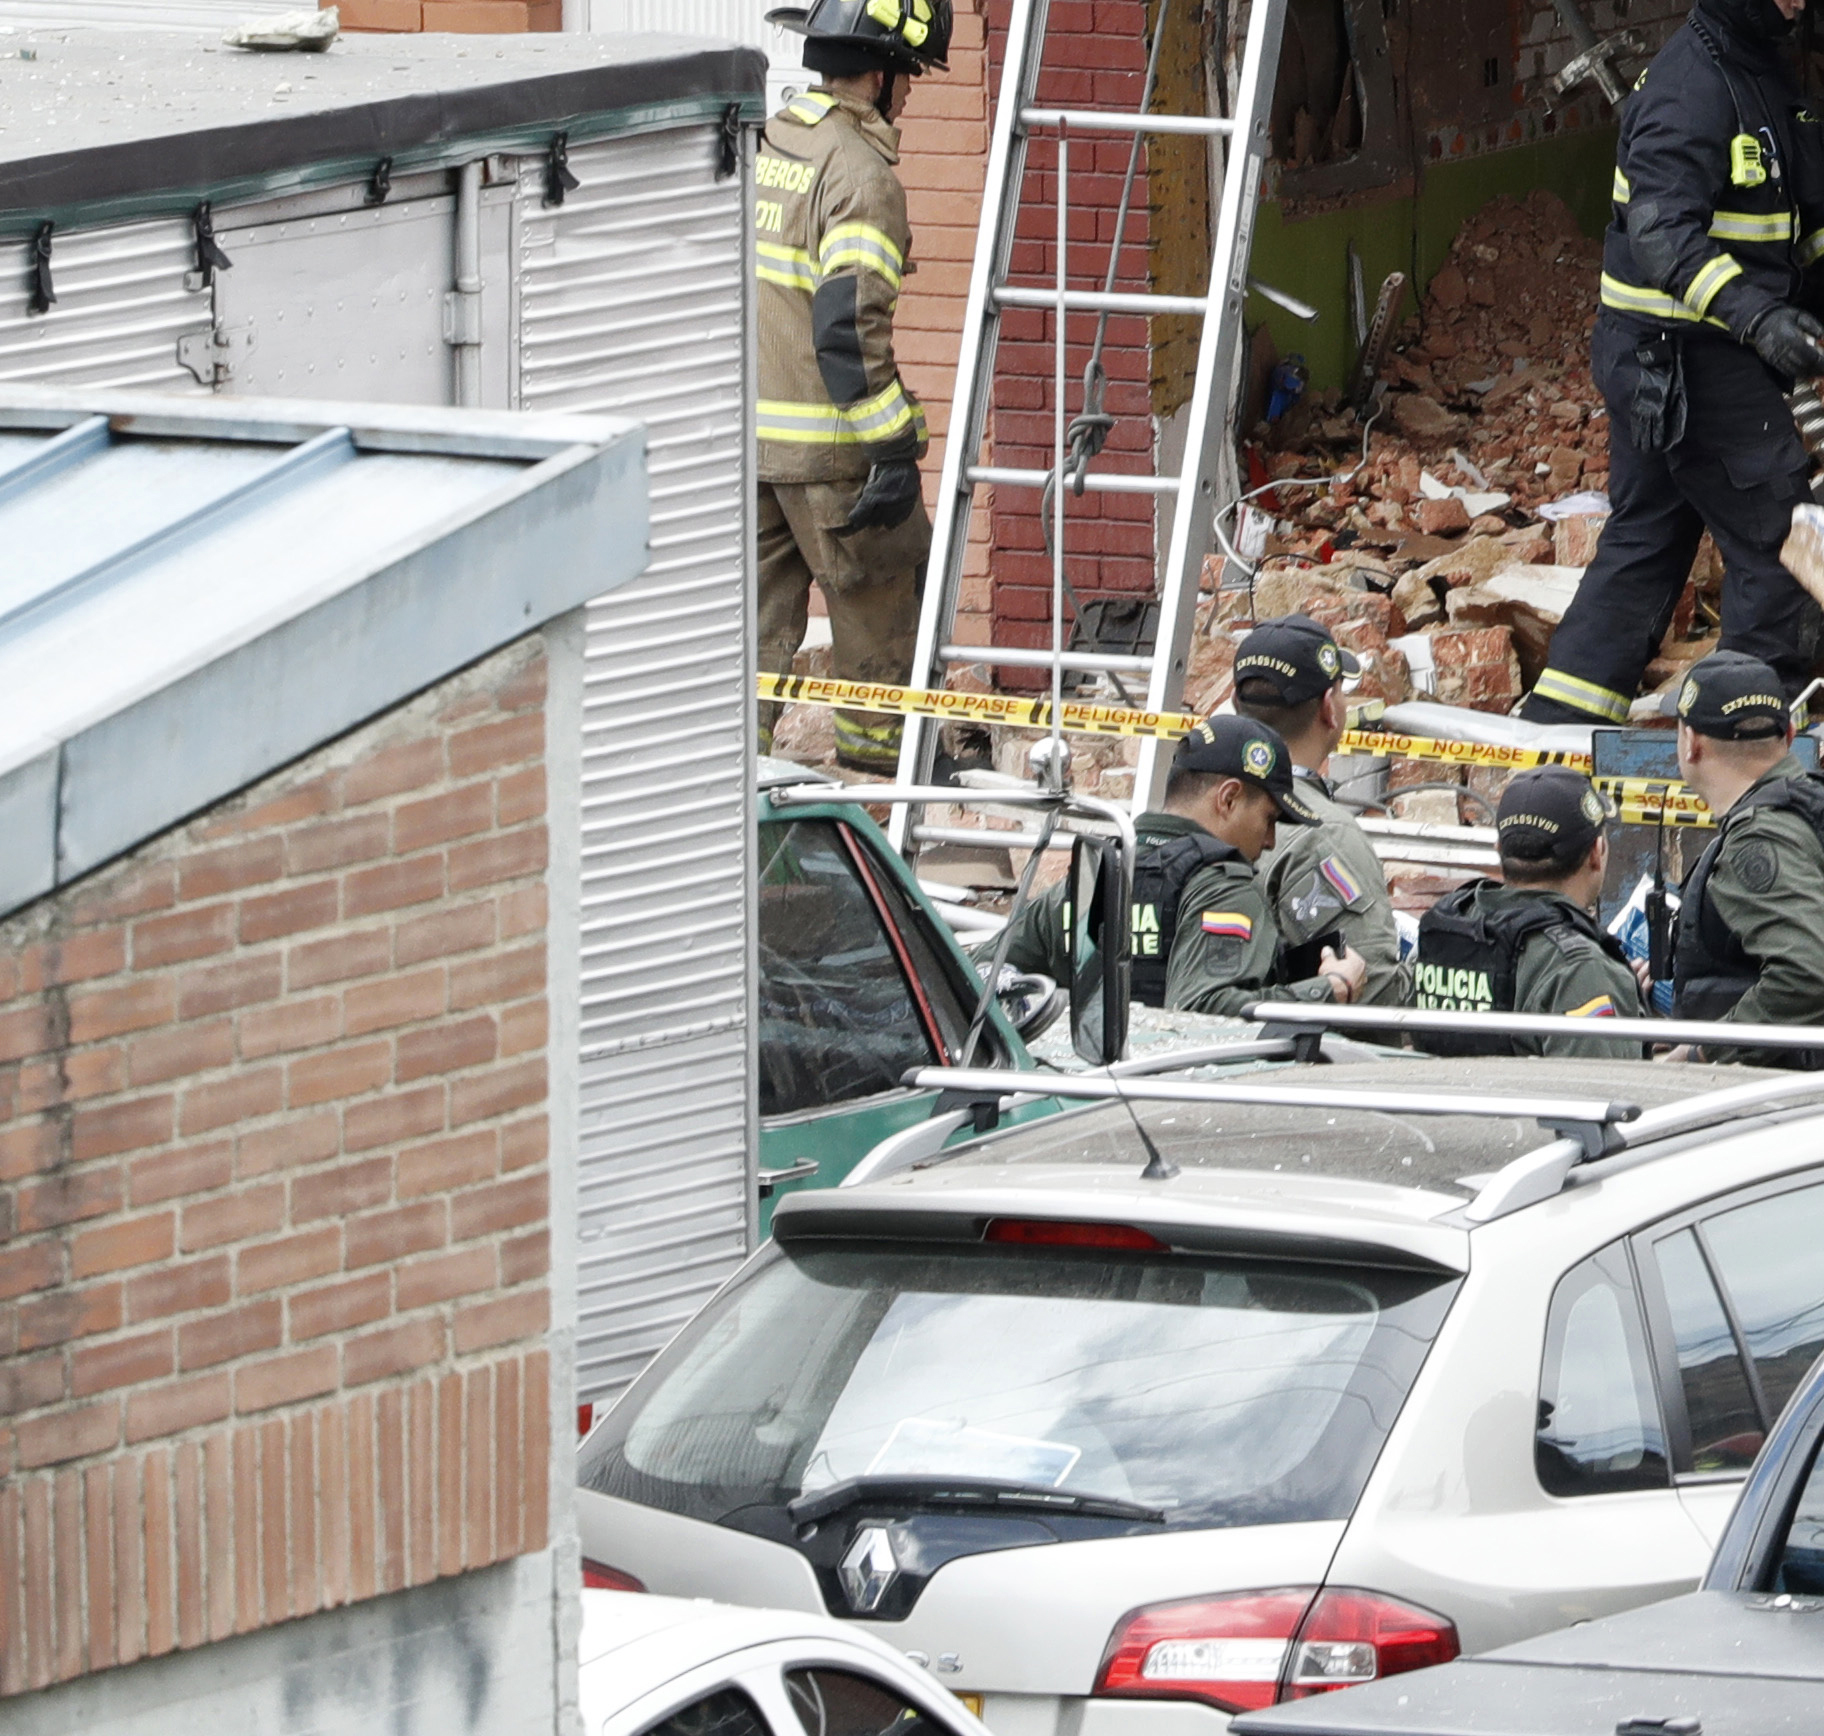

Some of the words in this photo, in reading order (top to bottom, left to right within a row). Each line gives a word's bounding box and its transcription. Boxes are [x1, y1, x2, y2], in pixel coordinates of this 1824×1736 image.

[807, 682, 904, 703] PELIGRO
[924, 693, 957, 708] NO
[963, 696, 1019, 714] PASE
[1064, 705, 1160, 727] PELIGRO
[1433, 739, 1465, 757] NO
[1471, 745, 1525, 763] PASE
[1415, 962, 1493, 1003] POLICIA
